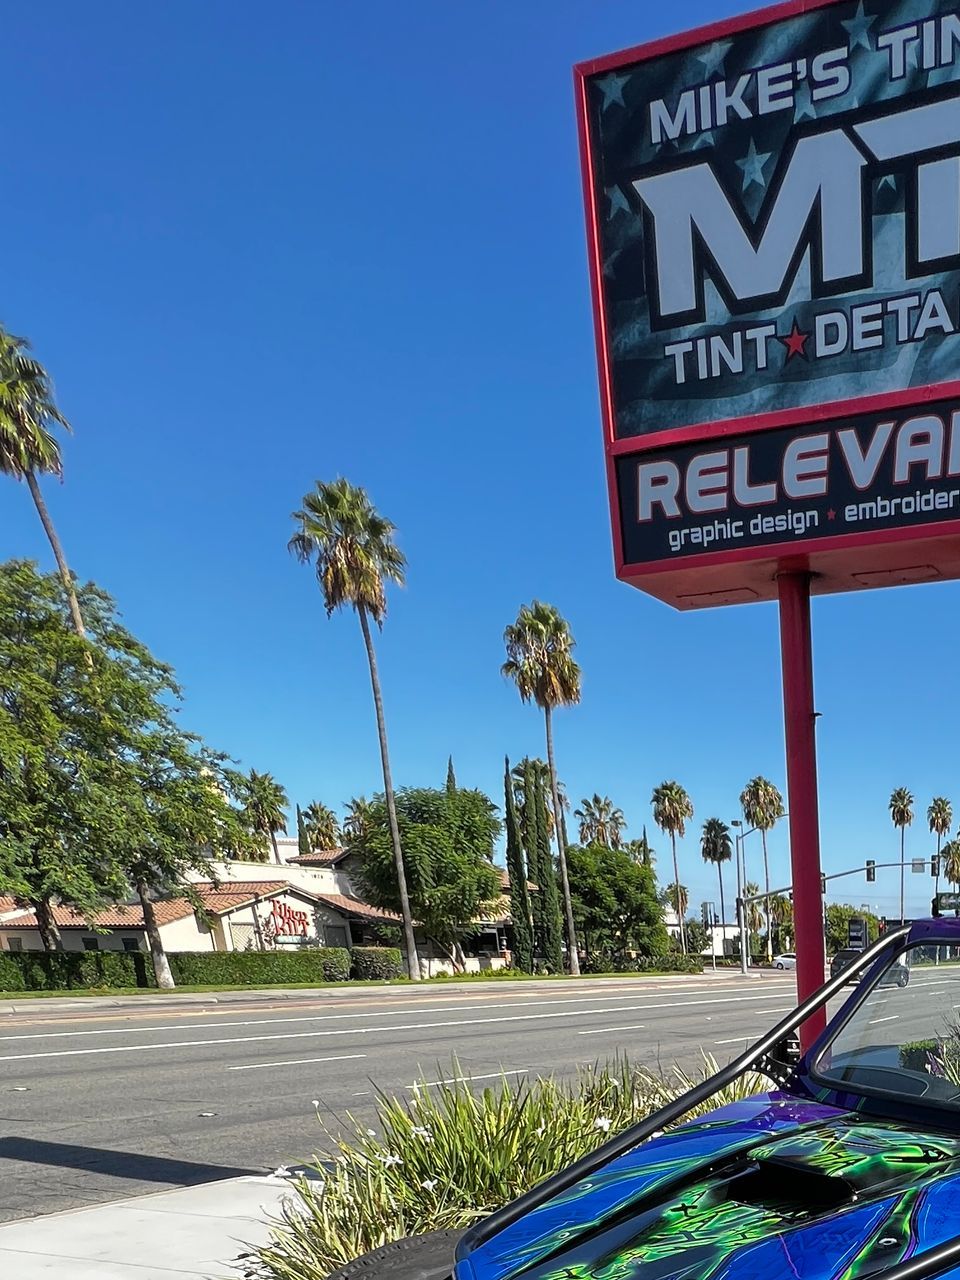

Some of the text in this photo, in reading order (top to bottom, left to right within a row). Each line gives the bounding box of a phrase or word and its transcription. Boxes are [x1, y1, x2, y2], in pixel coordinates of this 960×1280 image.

[648, 45, 851, 146] MIKE'S
[664, 323, 776, 385] TINT
[668, 517, 745, 552] graphic
[749, 509, 819, 535] design
